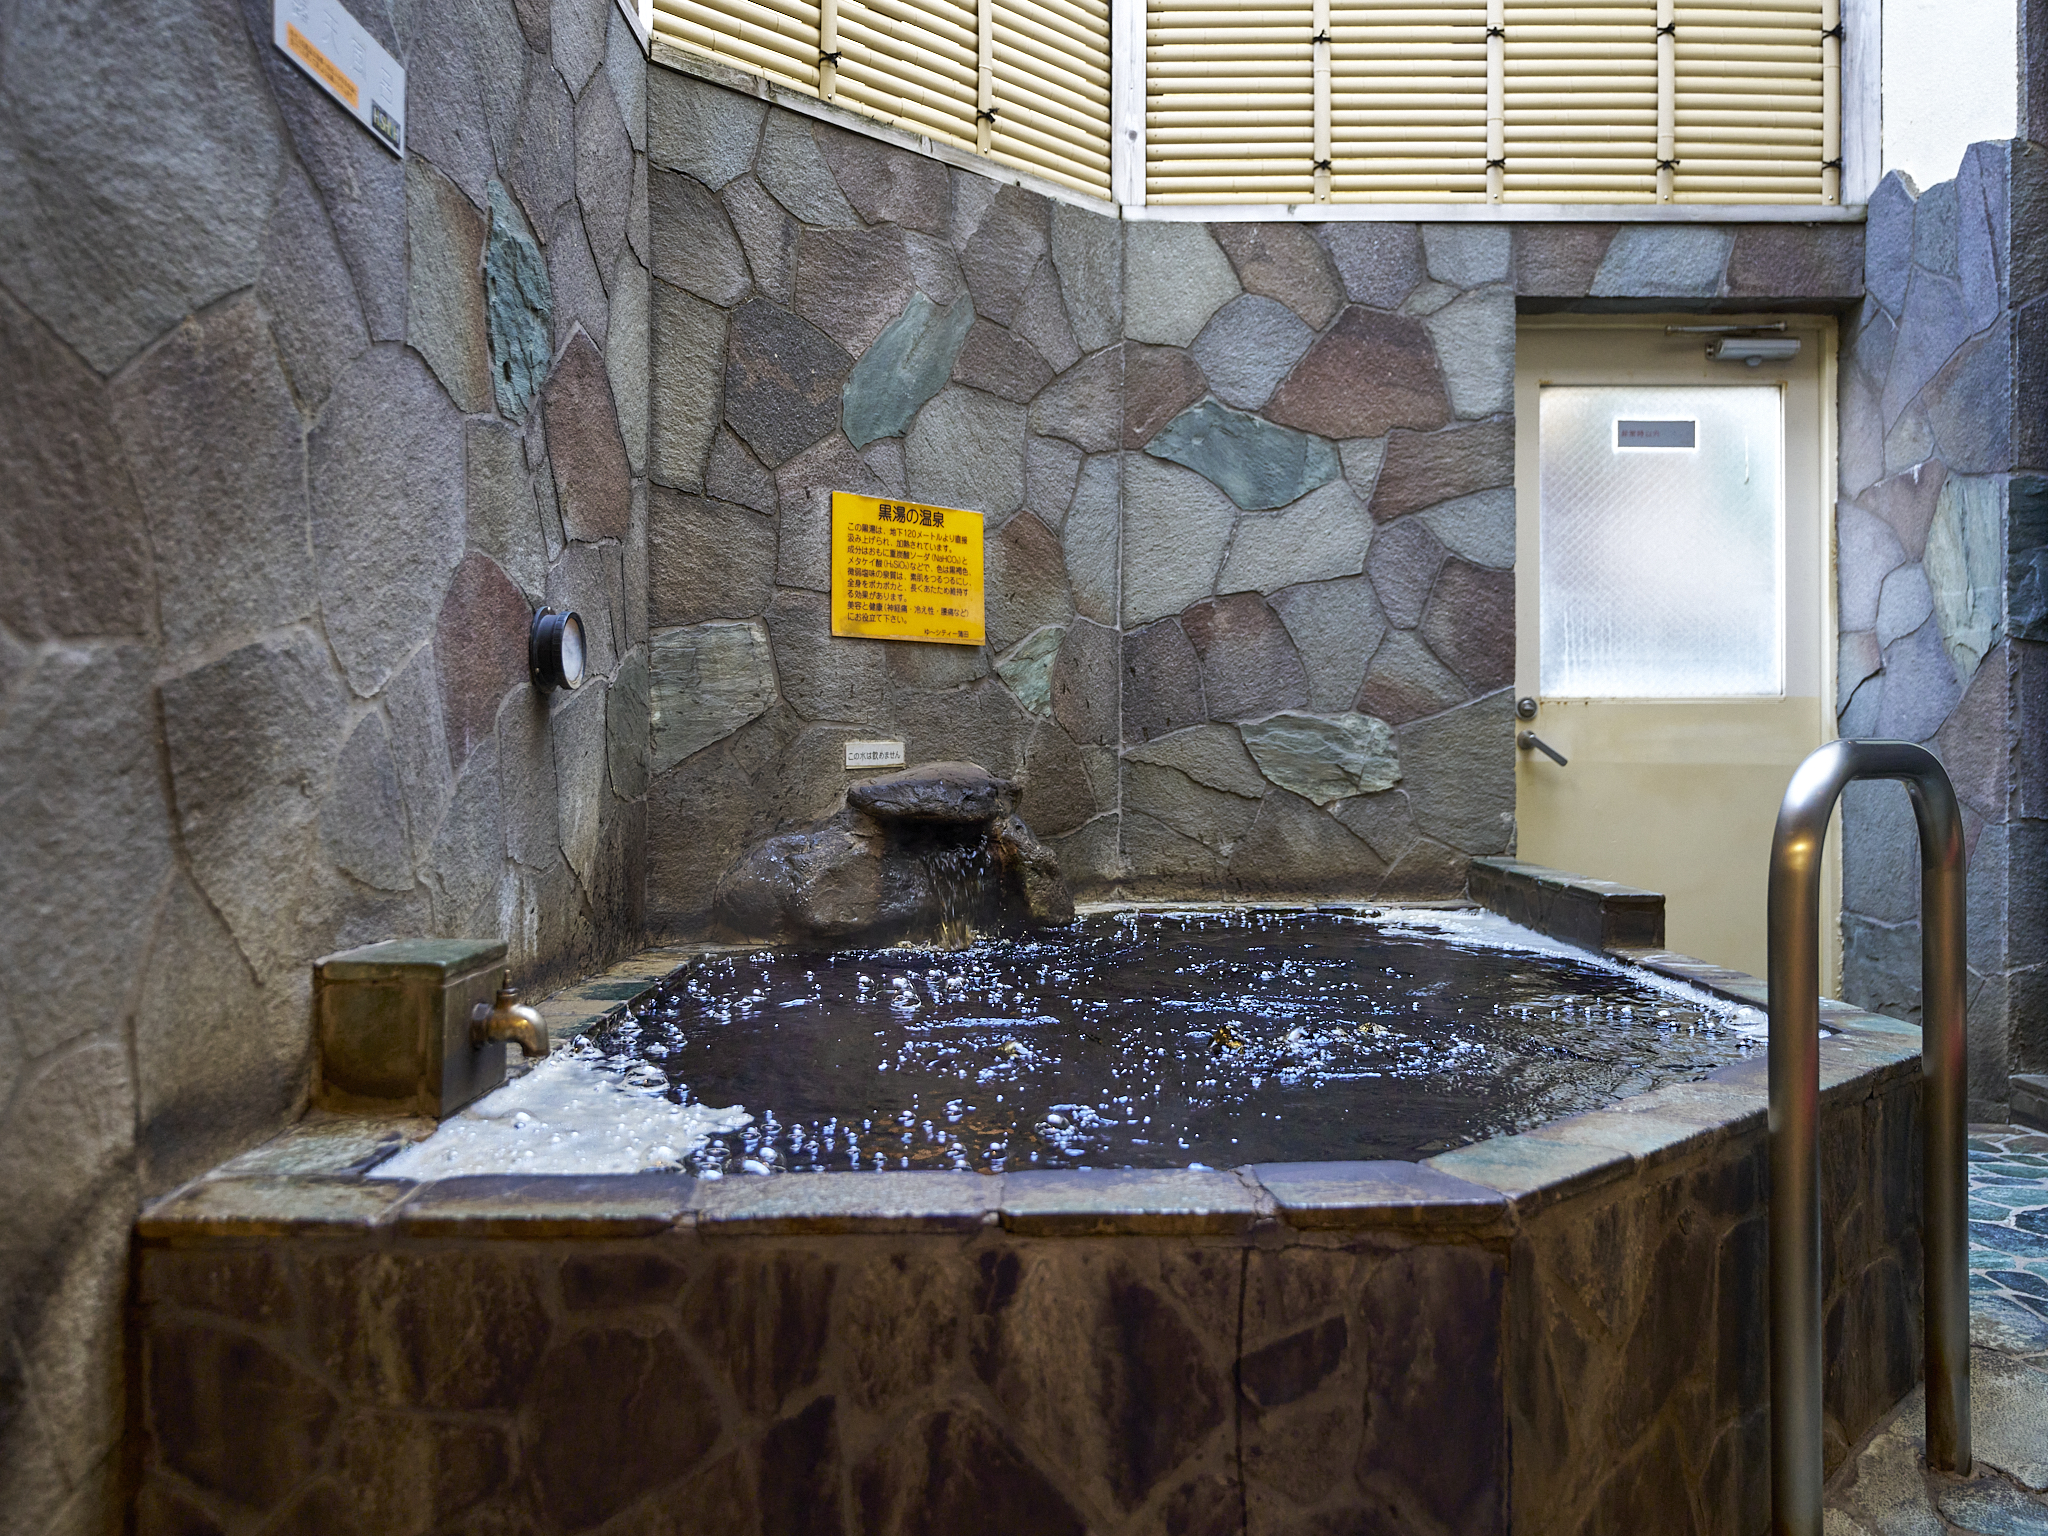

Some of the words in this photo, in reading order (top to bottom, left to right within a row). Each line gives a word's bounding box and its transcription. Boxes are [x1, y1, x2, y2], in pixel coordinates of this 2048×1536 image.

[878, 504, 944, 528] 黒湯の温泉
[847, 590, 908, 602] る効果があります。
[847, 612, 908, 624] にお役立て下さい。
[848, 751, 901, 761] この水は飲めません
